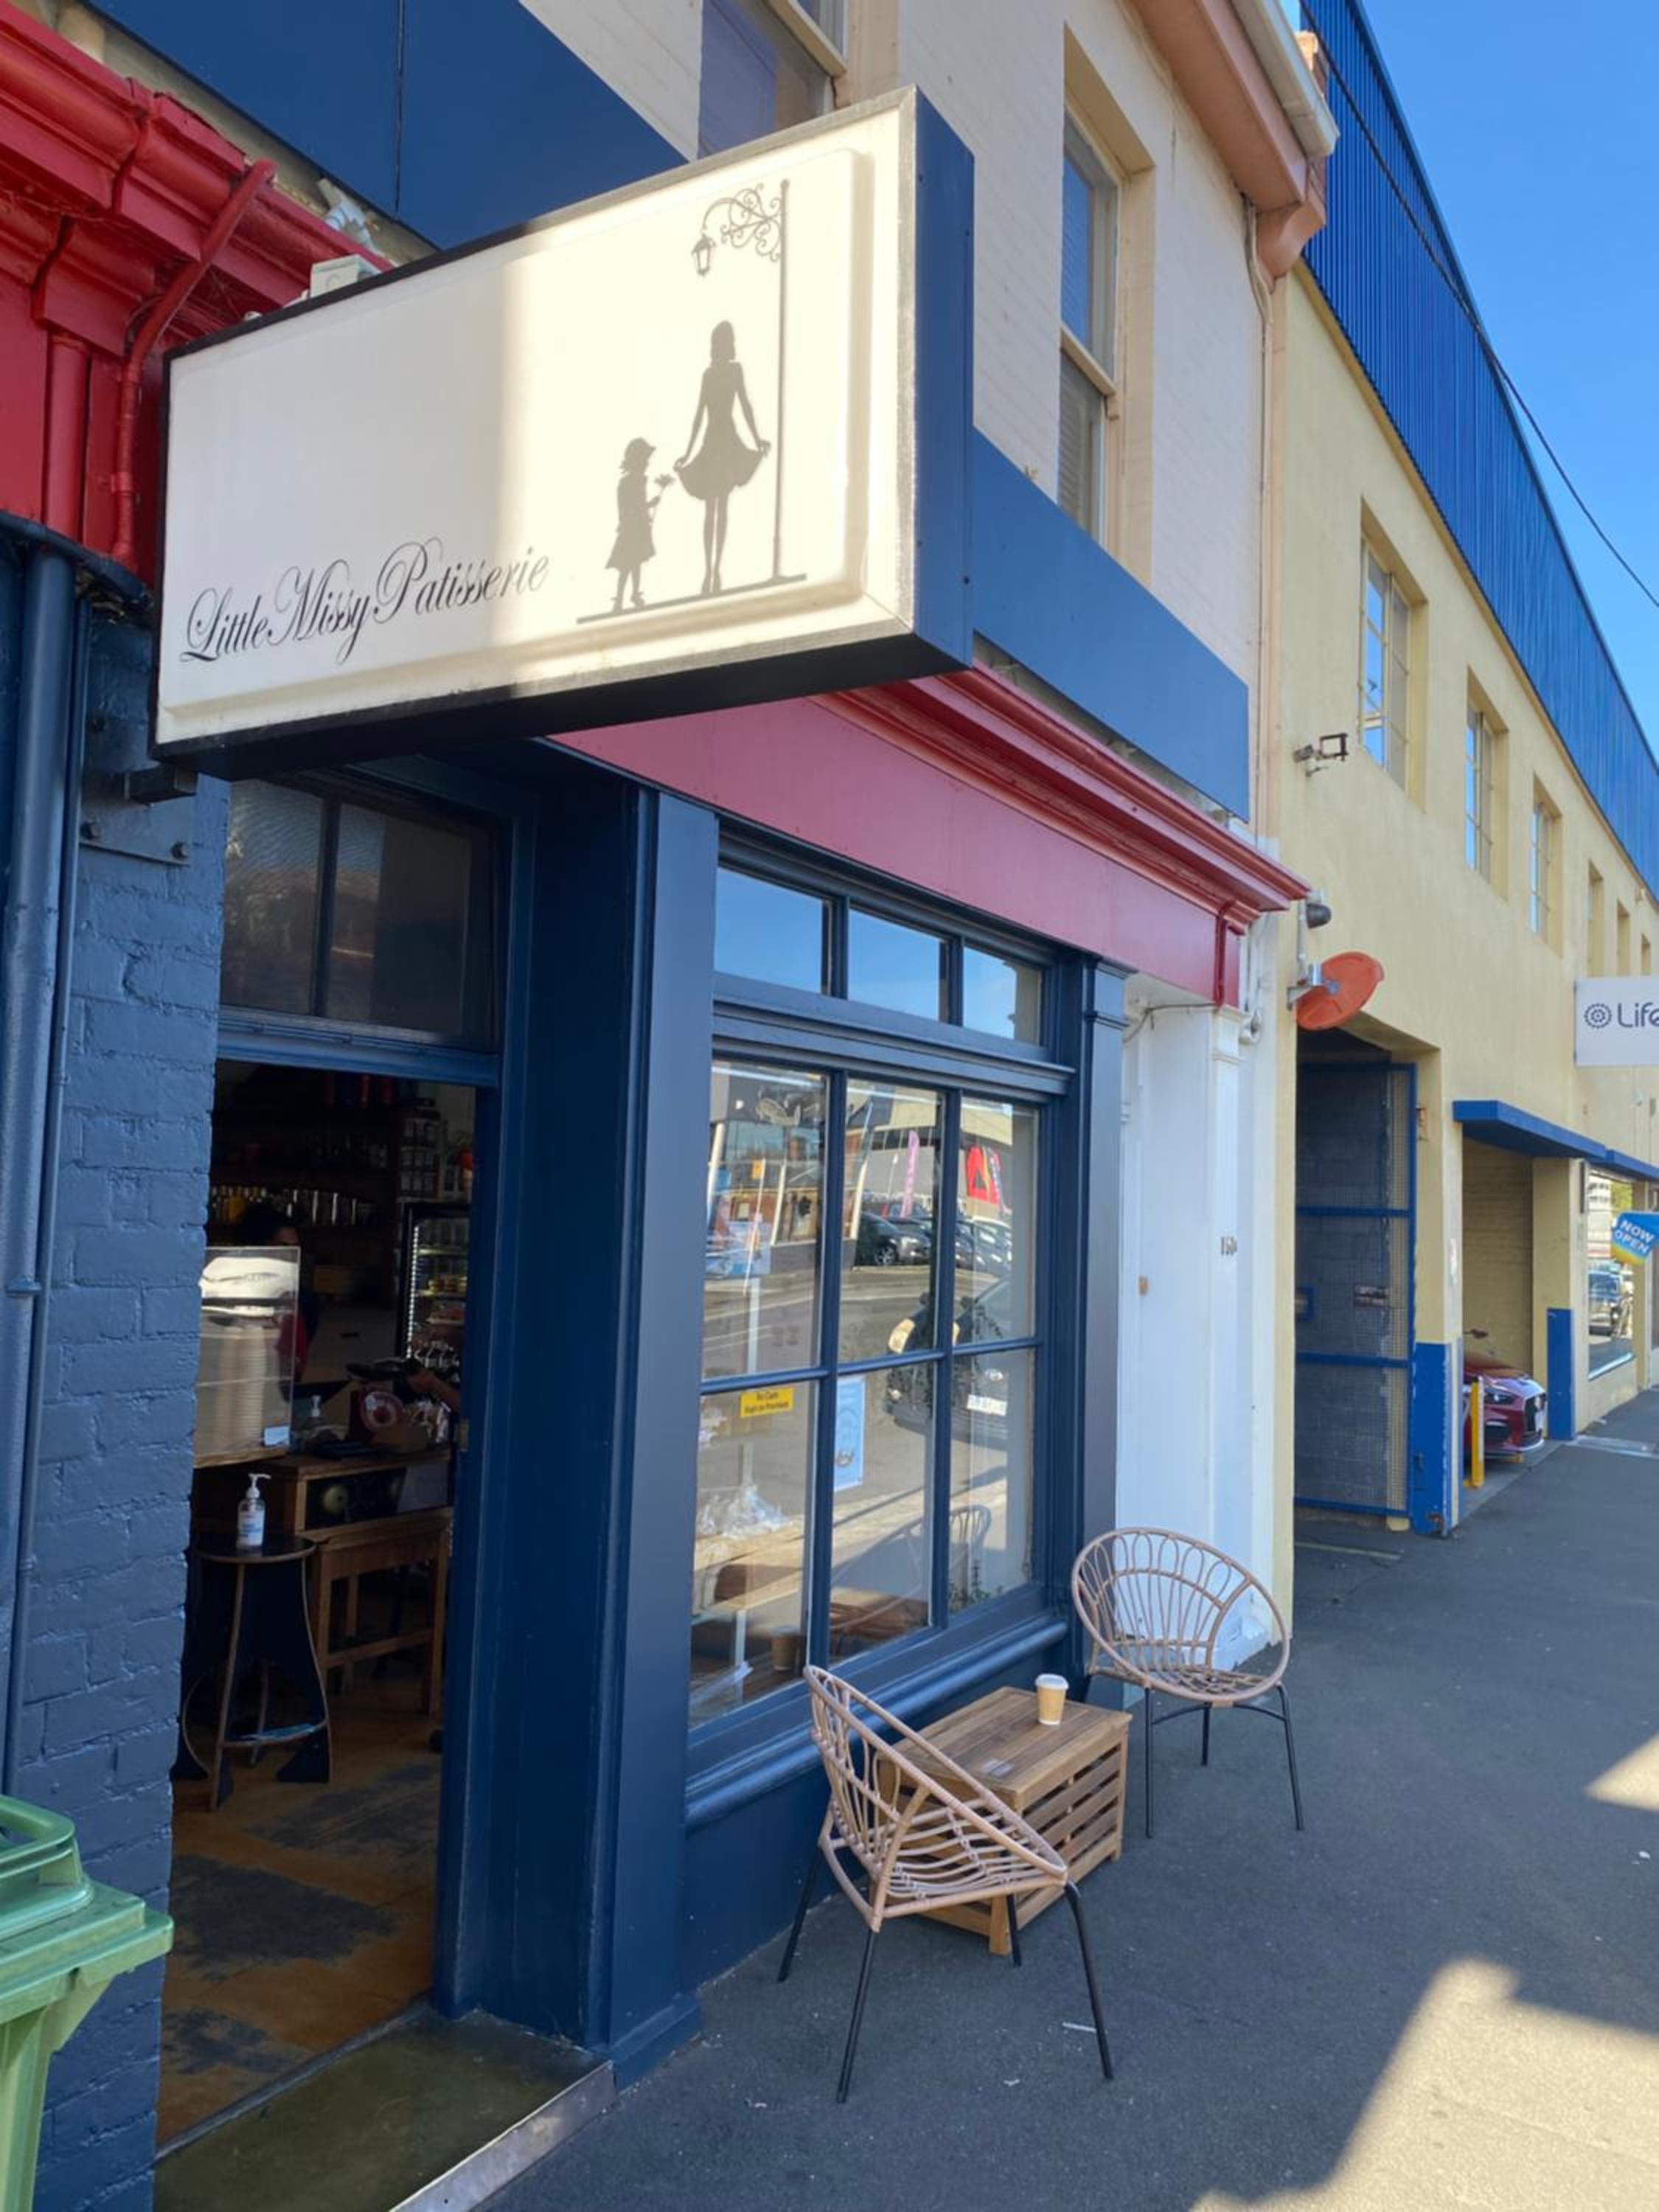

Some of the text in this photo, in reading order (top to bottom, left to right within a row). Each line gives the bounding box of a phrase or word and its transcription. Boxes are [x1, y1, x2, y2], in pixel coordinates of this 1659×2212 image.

[179, 536, 550, 665] Little Missy Patisserie
[1615, 1229, 1650, 1254] OPEN
[1620, 1220, 1655, 1243] NOW
